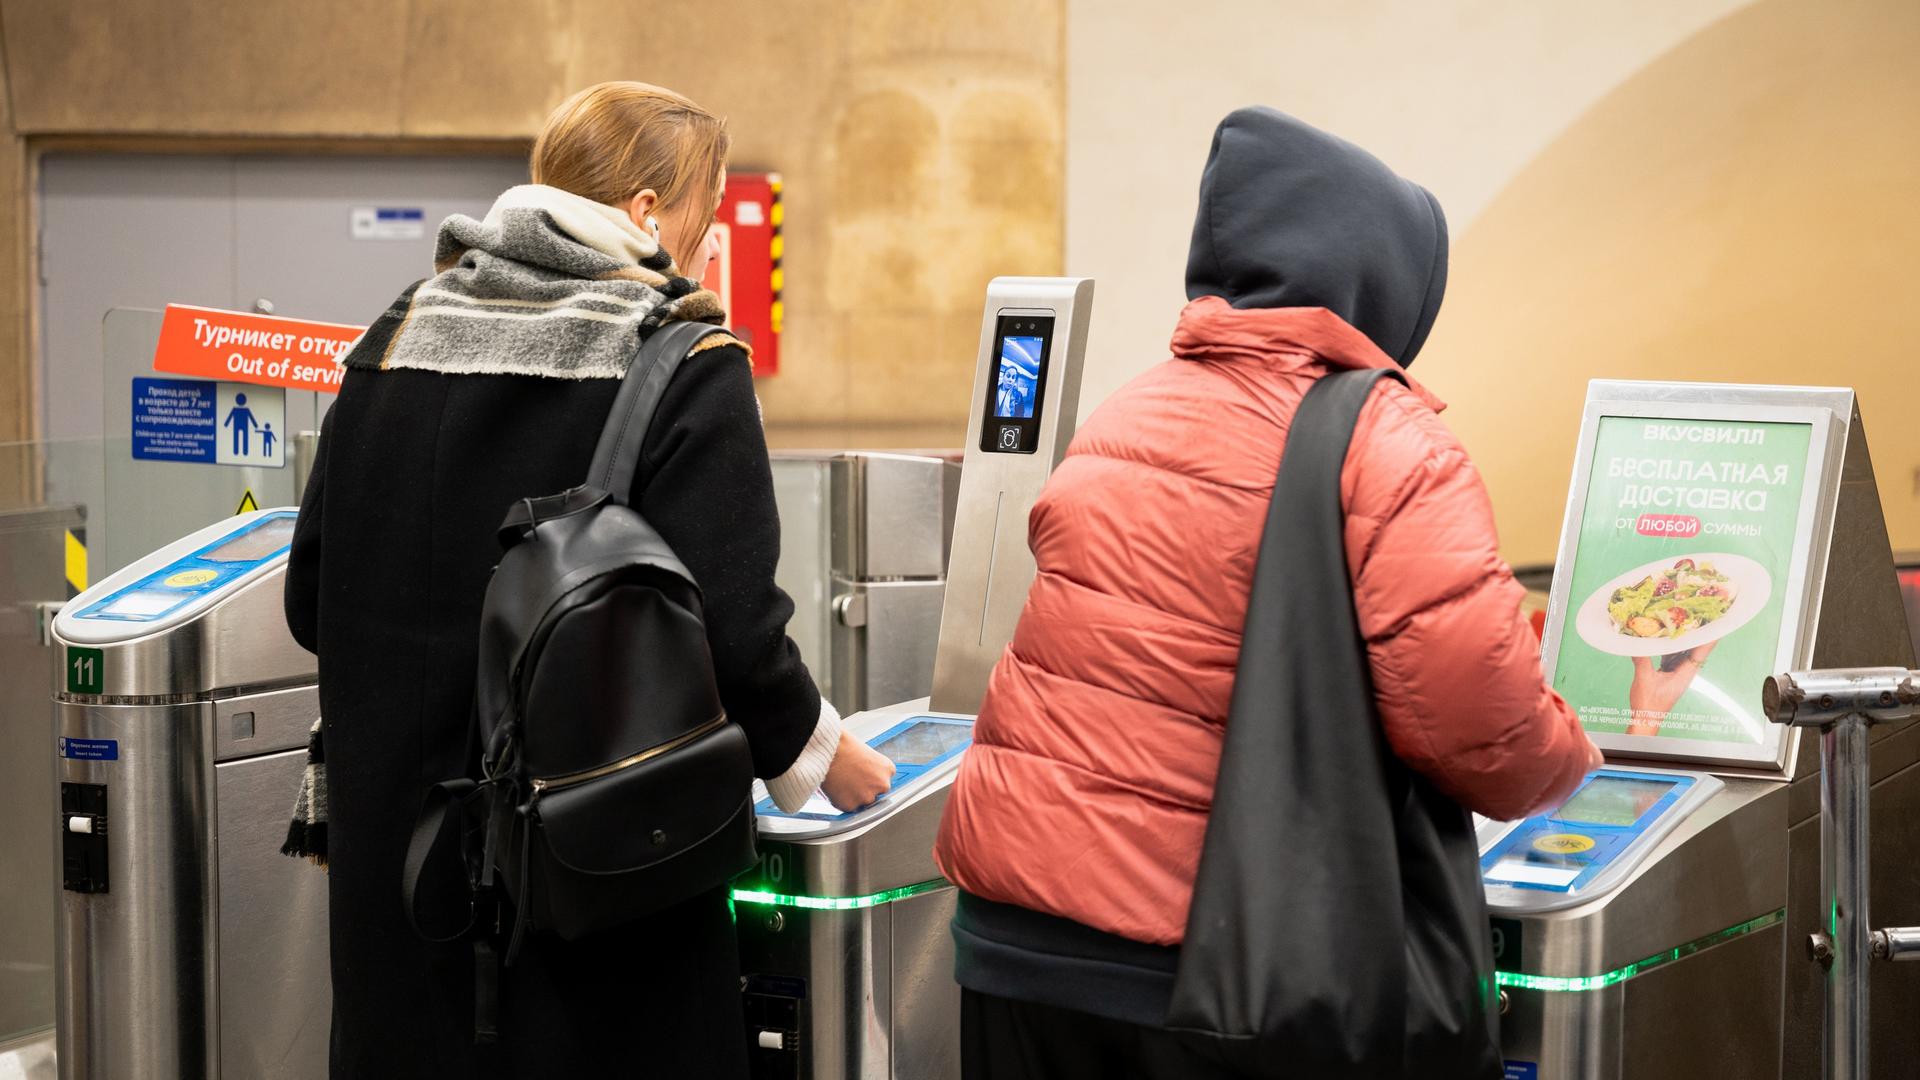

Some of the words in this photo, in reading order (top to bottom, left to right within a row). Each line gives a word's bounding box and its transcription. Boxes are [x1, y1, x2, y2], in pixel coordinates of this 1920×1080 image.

[194, 318, 296, 350] Турникет
[227, 352, 264, 376] Out
[267, 358, 291, 380] of
[148, 386, 177, 397] Проход
[191, 397, 197, 408] 7
[1643, 425, 1766, 445] ВКУСВИЛЛ
[1615, 518, 1635, 529] ОТ
[1639, 517, 1698, 533] ЛЮБОЙ
[1703, 521, 1761, 536] СУММЫ
[74, 656, 94, 686] 11
[761, 852, 783, 882] 10
[1491, 927, 1505, 958] 9
